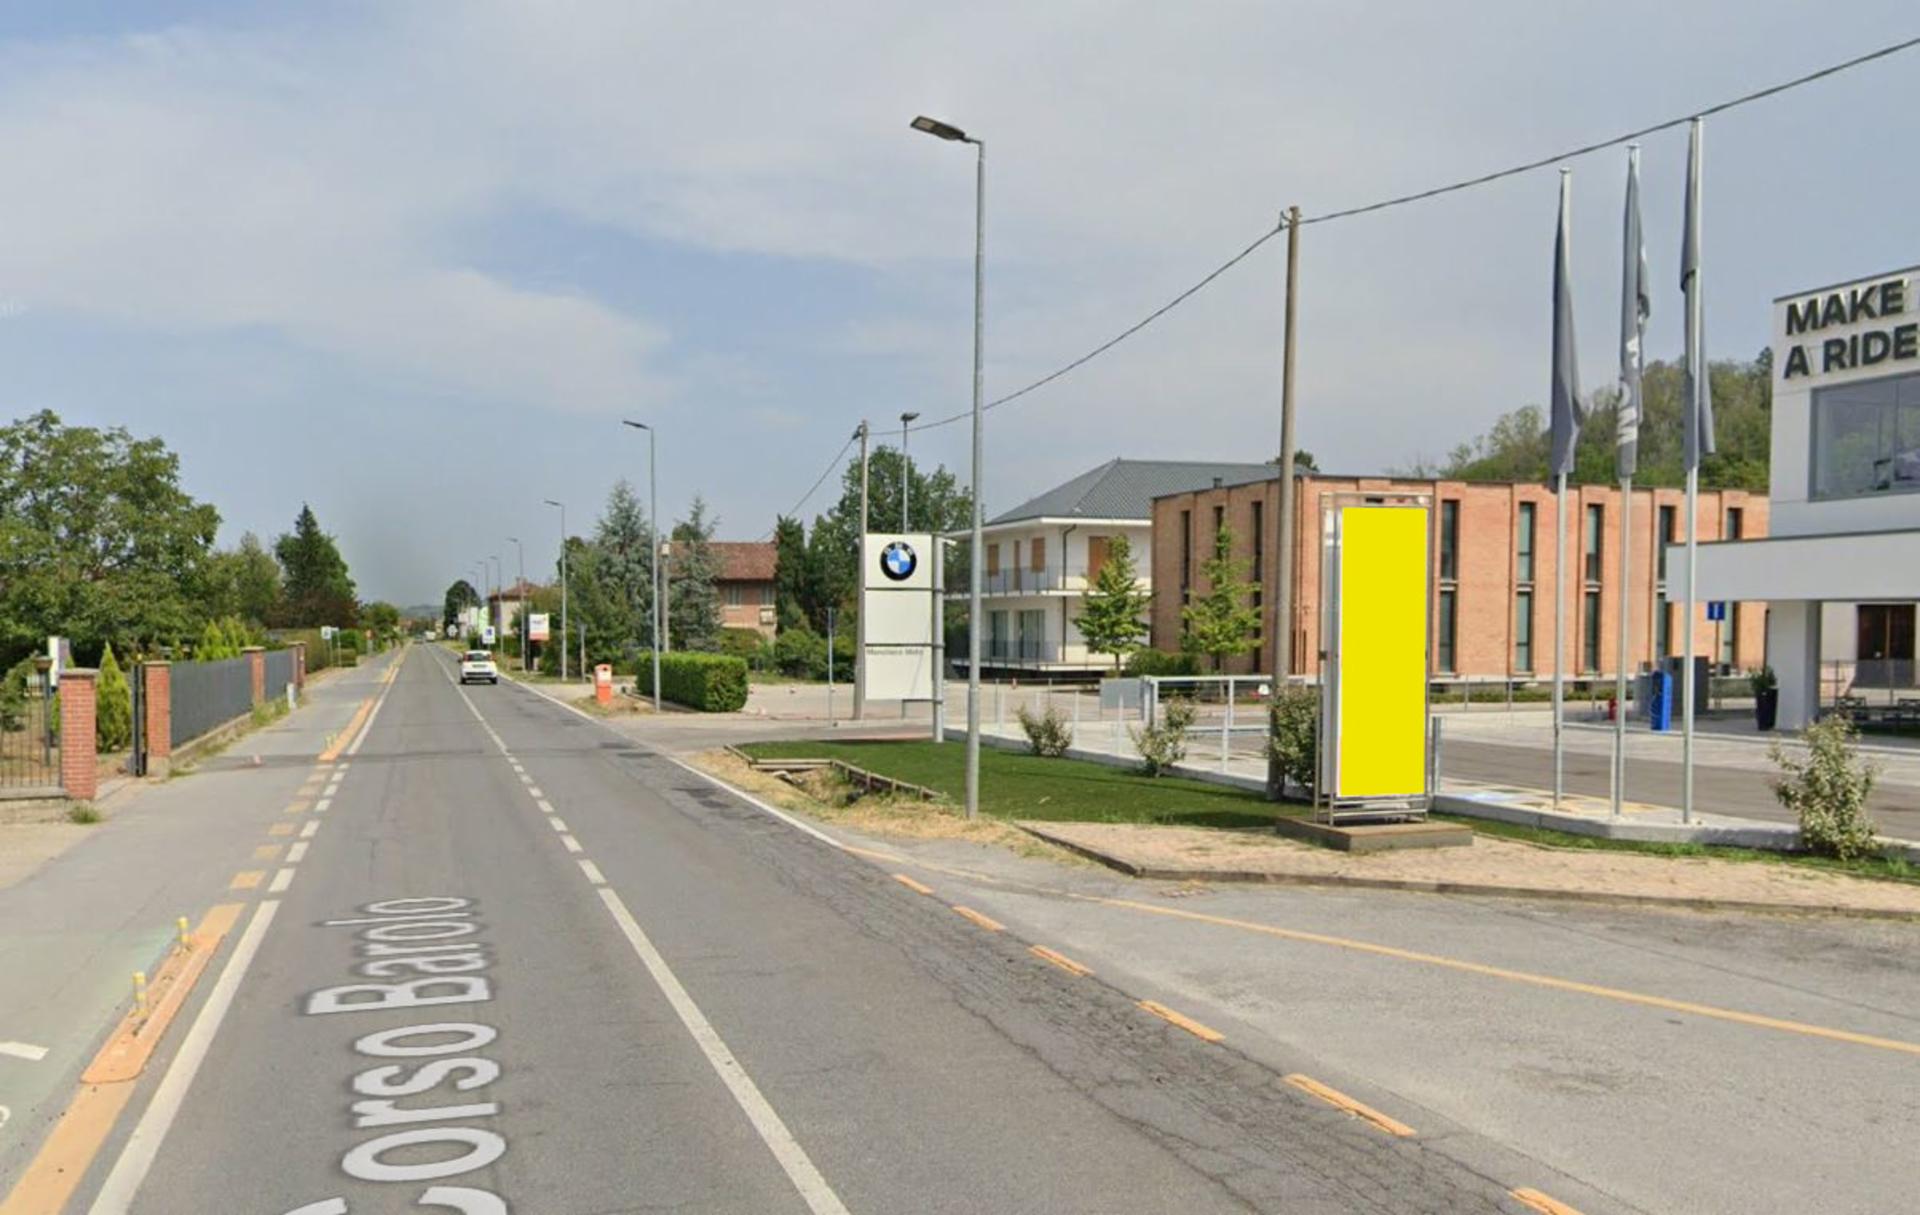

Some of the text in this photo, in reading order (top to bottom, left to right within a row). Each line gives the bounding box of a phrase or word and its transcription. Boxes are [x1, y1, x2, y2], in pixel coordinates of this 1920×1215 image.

[1786, 279, 1904, 336] MAKE
[1783, 323, 1919, 379] A RIDE
[307, 896, 490, 1015] Barolo
